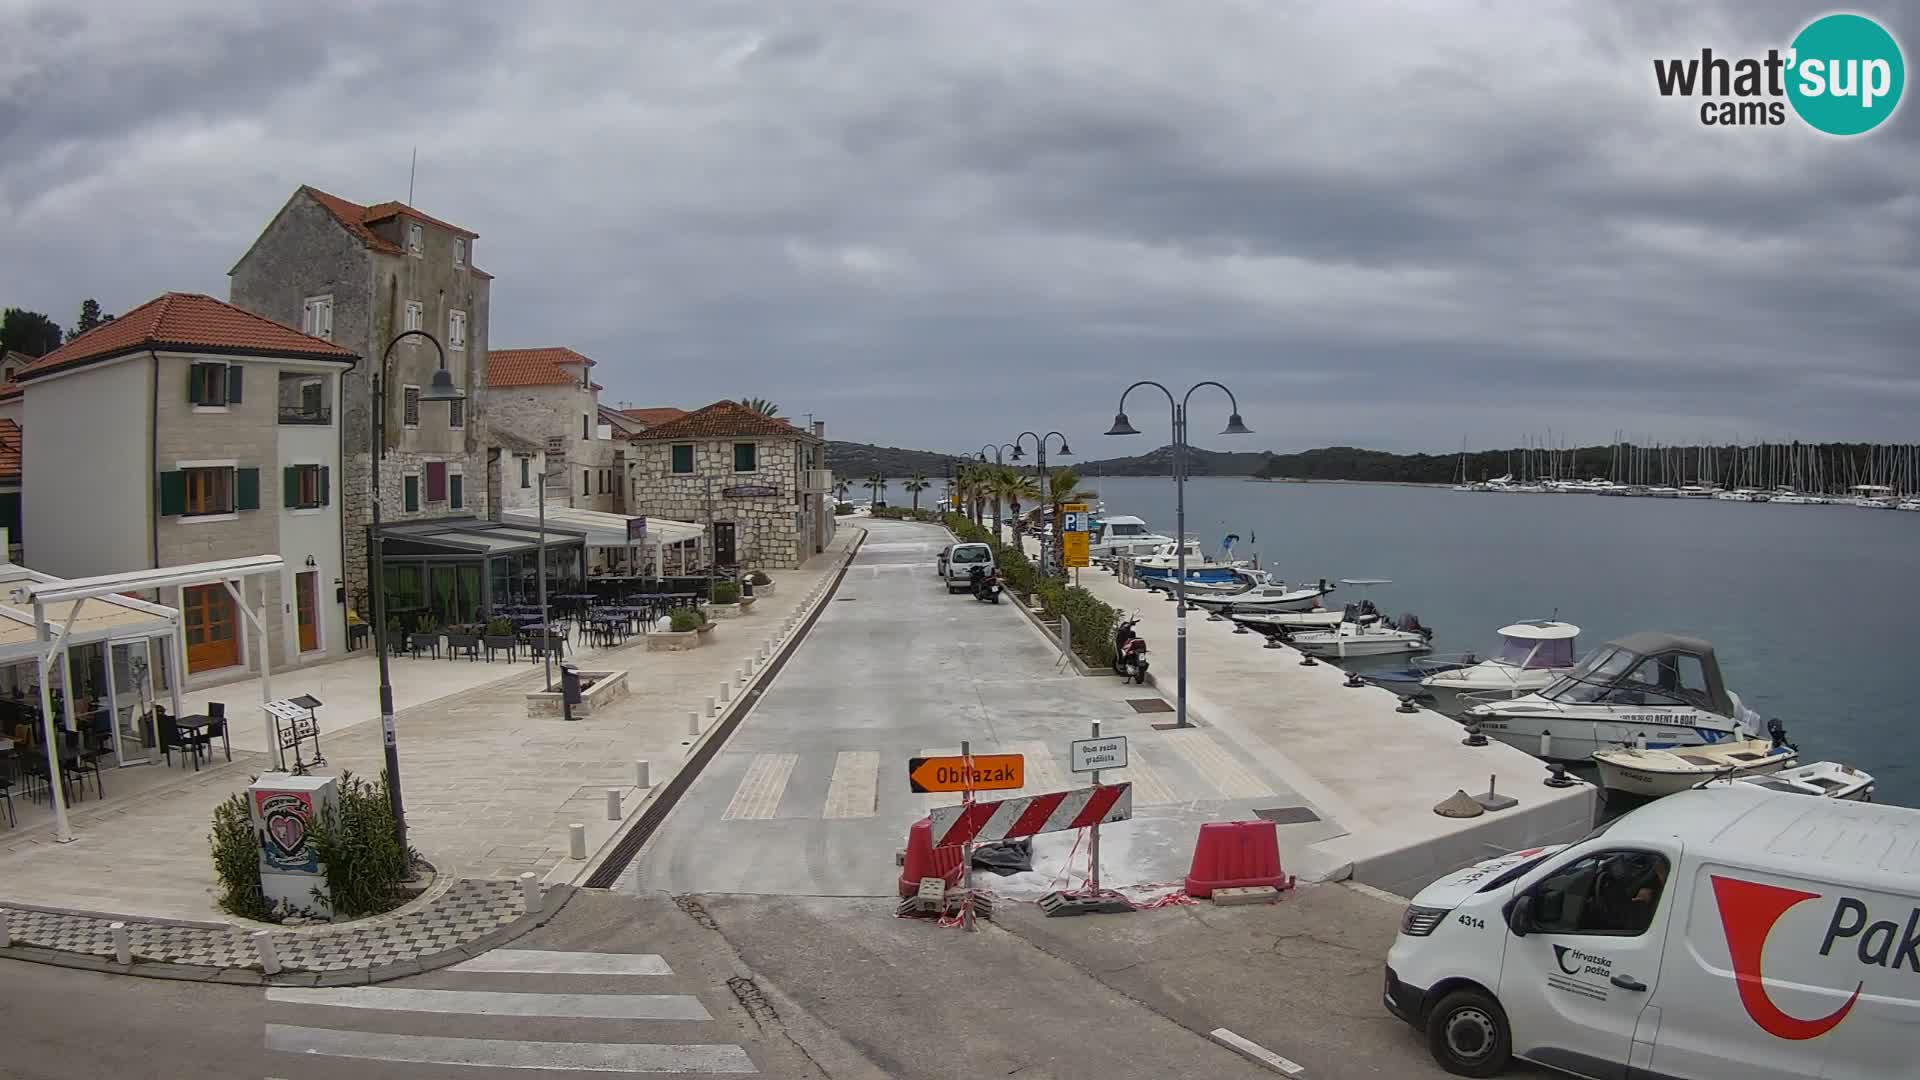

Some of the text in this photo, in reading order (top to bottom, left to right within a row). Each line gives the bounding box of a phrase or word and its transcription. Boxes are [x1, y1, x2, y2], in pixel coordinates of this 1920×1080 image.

[1654, 714, 1673, 724] RENT
[1673, 714, 1679, 724] A
[1680, 714, 1697, 726] BOAT
[1458, 914, 1485, 930] 4314
[1819, 896, 1920, 973] Pak
[1571, 949, 1612, 967] Hrvatska
[1584, 964, 1611, 978] pošta
